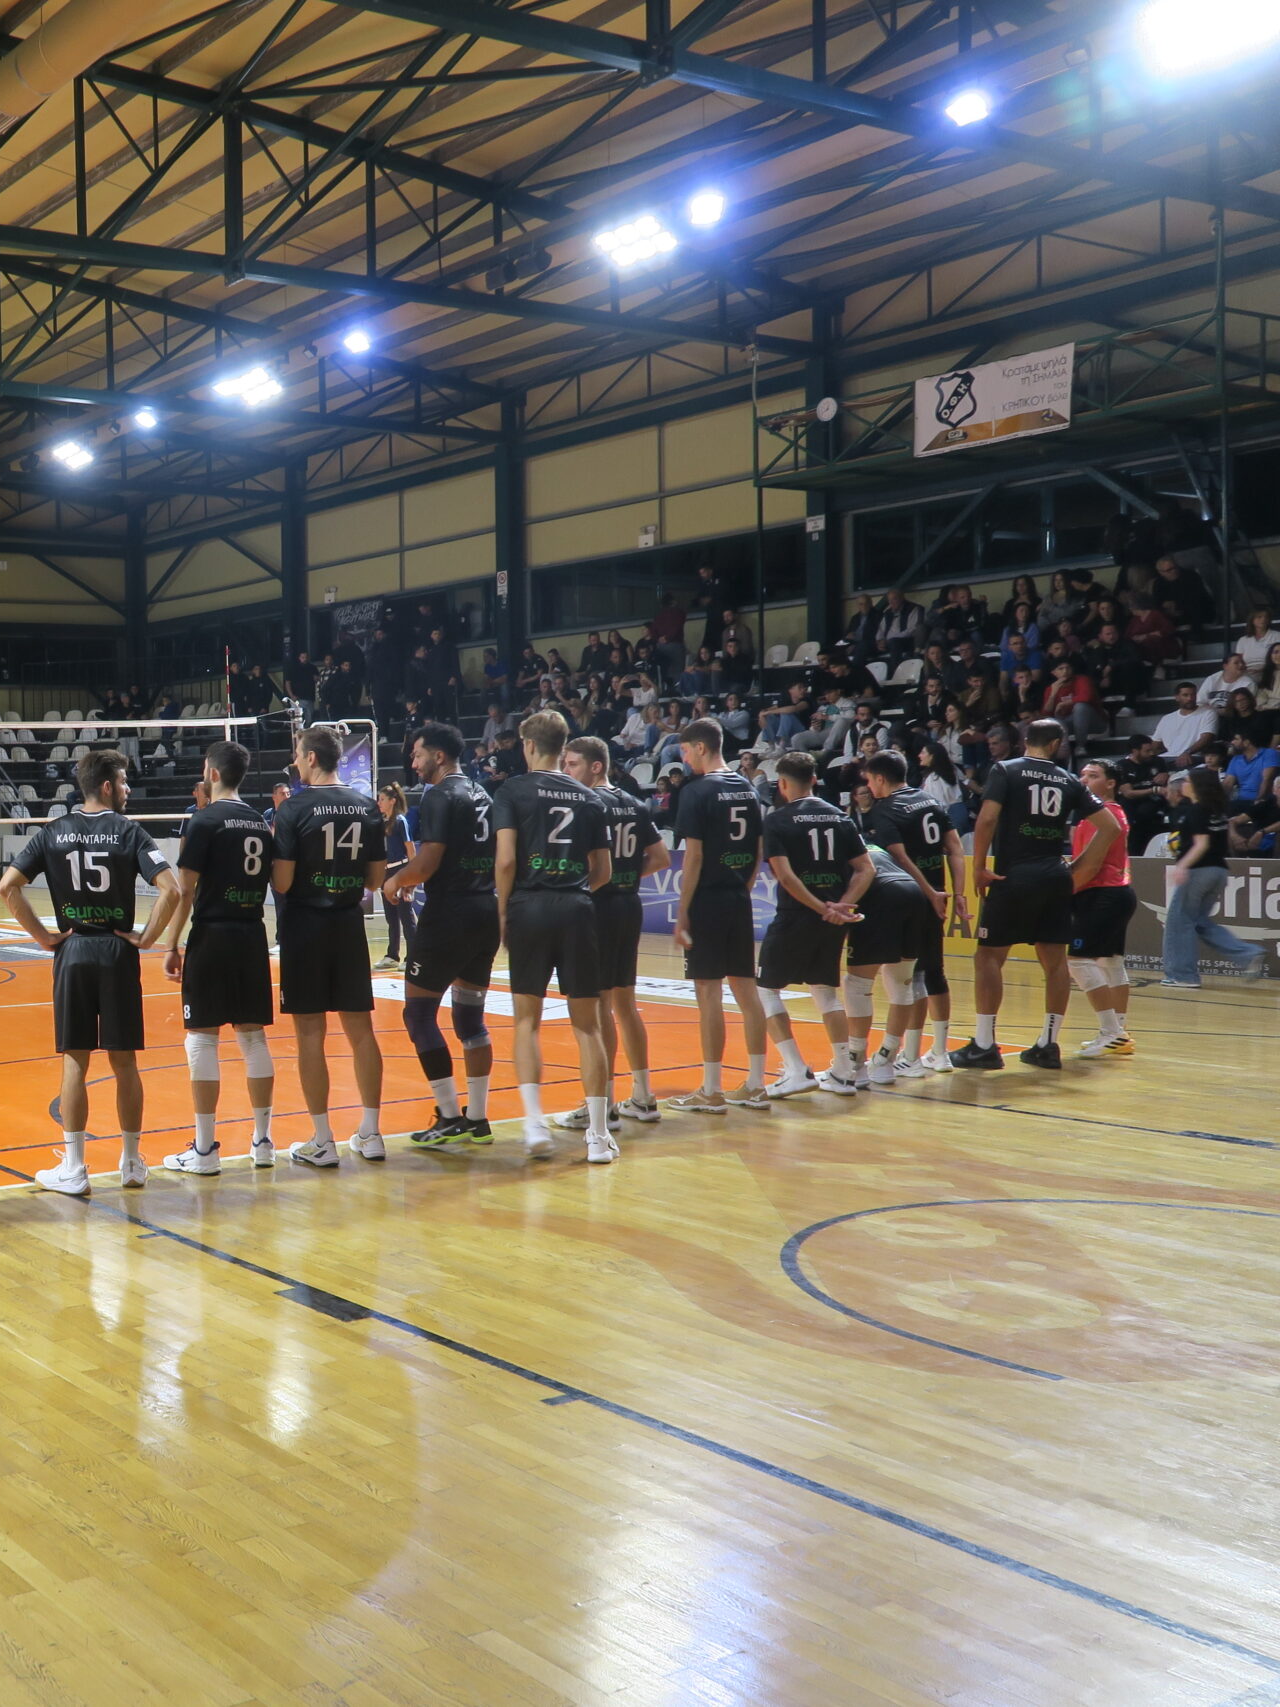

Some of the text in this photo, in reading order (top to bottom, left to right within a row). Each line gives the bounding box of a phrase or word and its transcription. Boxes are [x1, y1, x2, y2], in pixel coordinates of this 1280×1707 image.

[1021, 770, 1068, 785] ΑΝΔΡΕΑΔΗΣ
[314, 806, 368, 816] MIHAJLOVIC
[538, 789, 586, 801] MAKINEN
[1028, 784, 1062, 816] 10
[56, 832, 119, 845] ΚΑΦΑΝΤΑΡΗΣ
[474, 804, 489, 842] 3
[547, 806, 575, 844] 2
[729, 806, 747, 840] 5
[923, 812, 940, 844] 6
[244, 837, 263, 875] 8
[322, 822, 363, 860] 14
[614, 822, 637, 858] 16
[808, 828, 834, 860] 11
[66, 851, 111, 892] 15
[65, 905, 124, 921] europe
[410, 962, 421, 976] 3
[184, 1004, 191, 1019] 8
